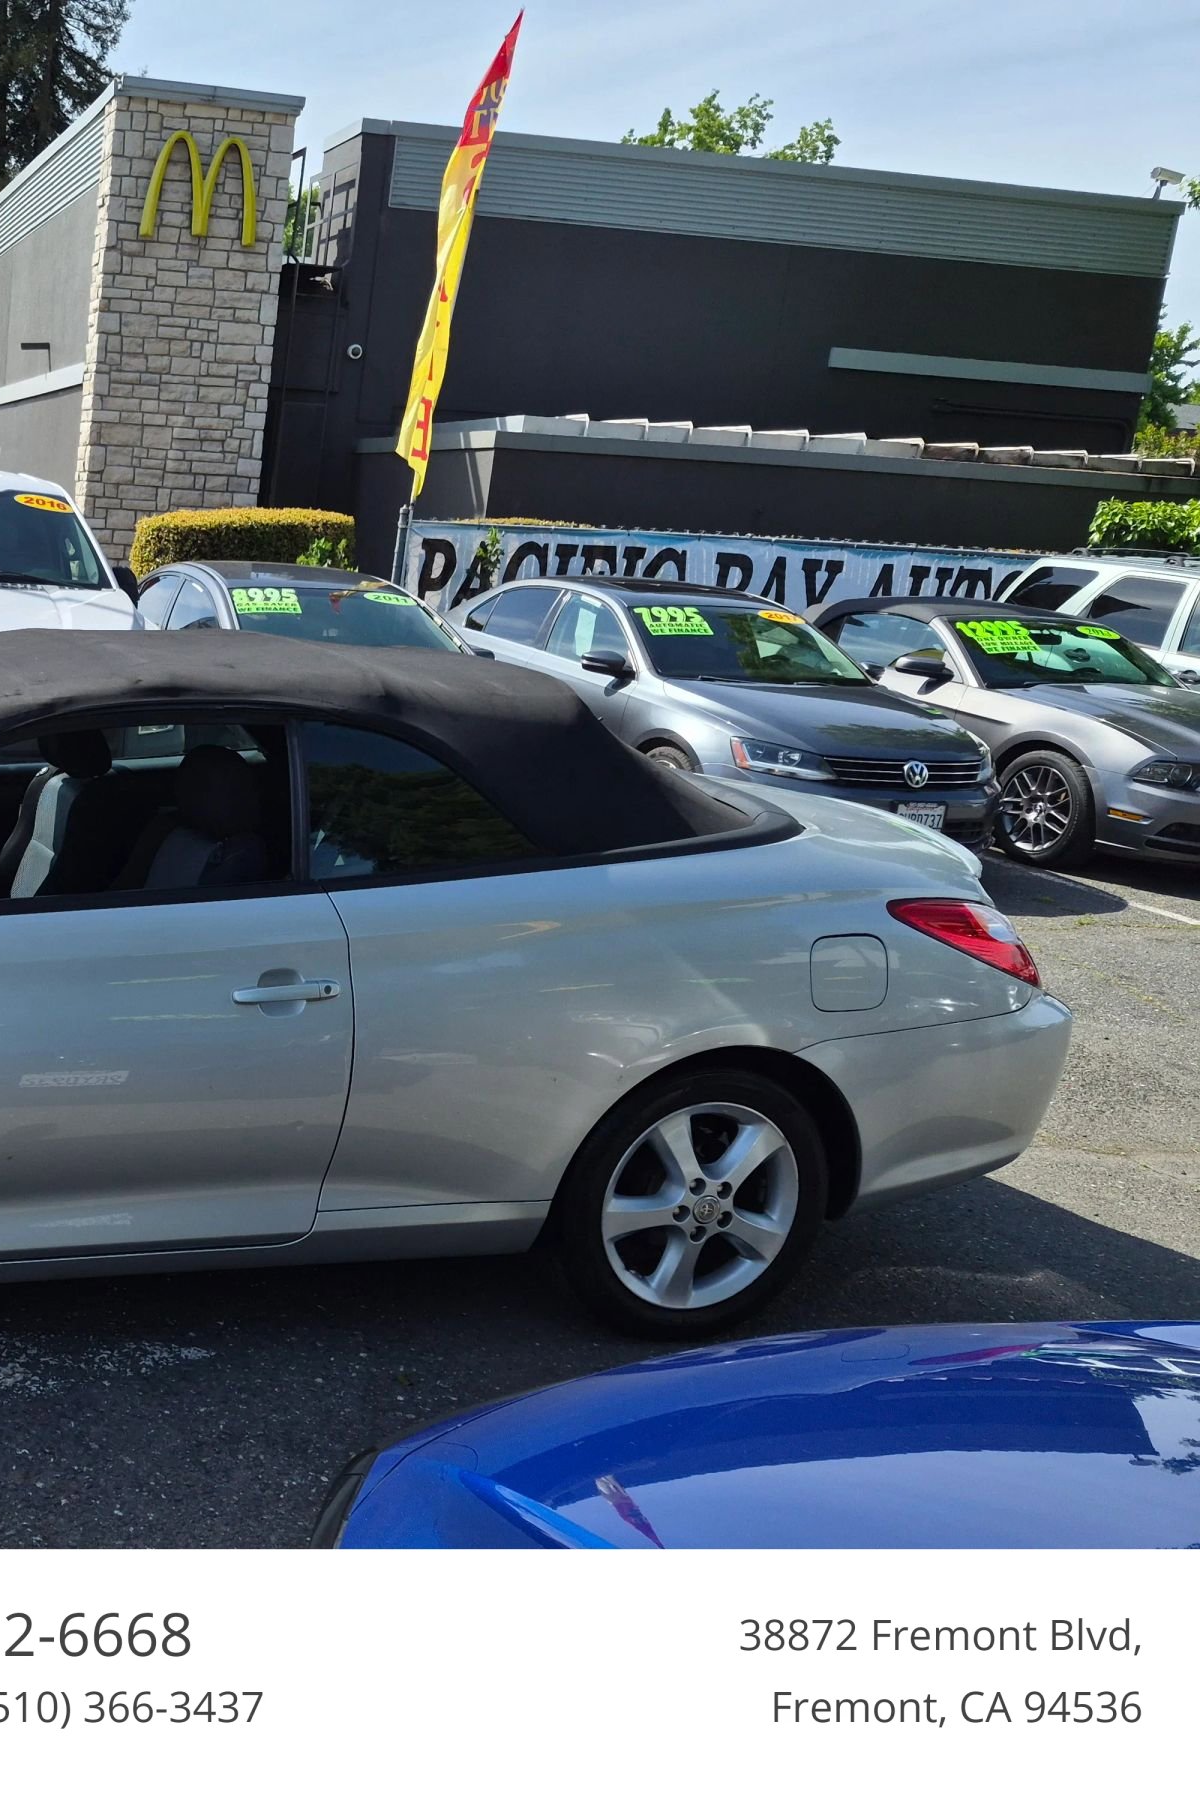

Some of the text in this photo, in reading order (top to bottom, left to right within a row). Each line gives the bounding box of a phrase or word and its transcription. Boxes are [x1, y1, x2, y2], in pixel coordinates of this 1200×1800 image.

[23, 496, 68, 511] 2016
[231, 588, 299, 602] 8995
[373, 594, 409, 604] 2011
[633, 607, 704, 623] 7995
[955, 620, 1030, 638] 12995
